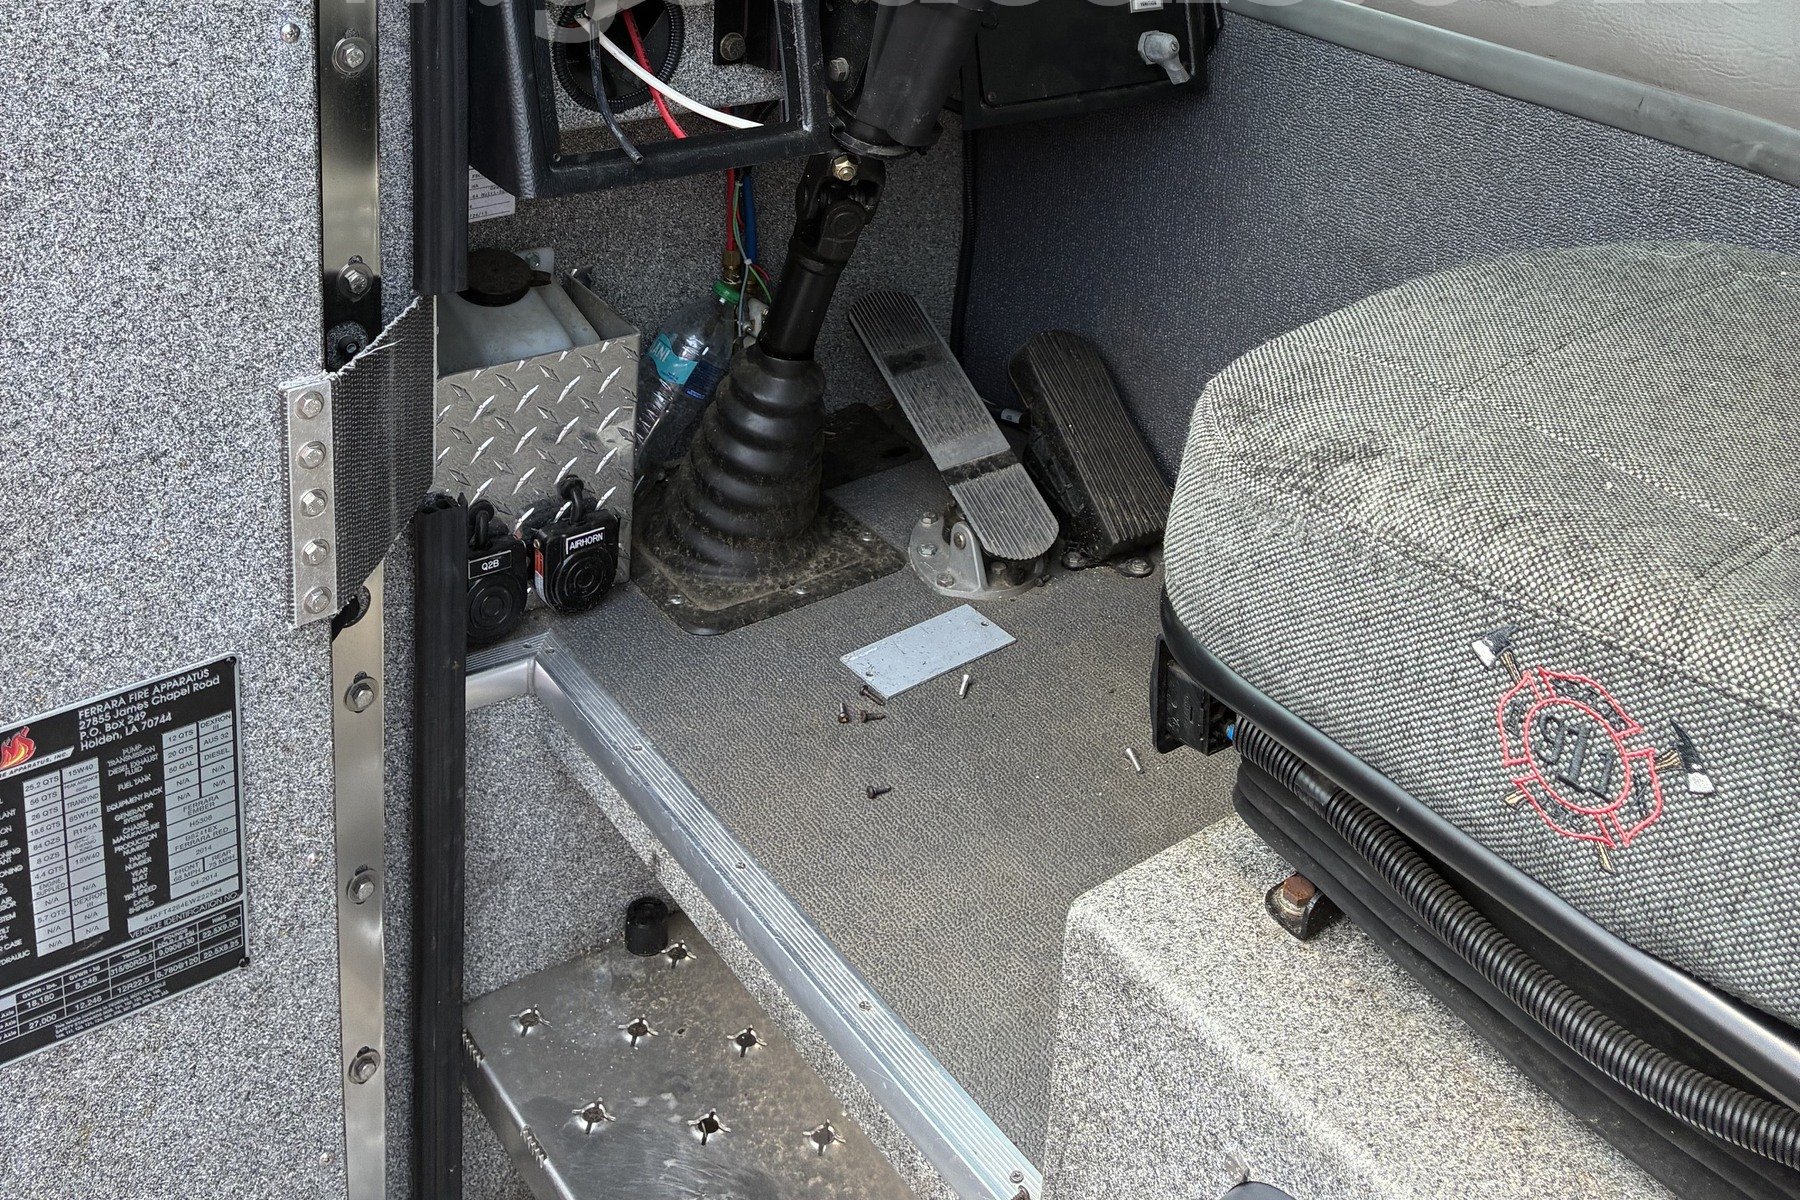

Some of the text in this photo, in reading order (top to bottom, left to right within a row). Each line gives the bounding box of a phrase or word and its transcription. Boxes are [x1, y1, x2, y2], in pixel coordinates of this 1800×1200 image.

[569, 533, 603, 550] AIRHORN
[482, 559, 500, 570] Q2B
[78, 668, 210, 720] FERRARA FIRE APPARATUS
[79, 675, 220, 731] 27855 James Chapel Road
[80, 712, 147, 740] P.O. Box 249
[201, 714, 231, 729] DEXRON
[80, 712, 172, 751] Holden, LA 70744
[168, 730, 194, 742] 12 QTS
[203, 732, 229, 746] AUS 32
[122, 744, 142, 756] PUMP
[167, 744, 194, 759] 20 QTS
[204, 748, 230, 760] DIESEL
[107, 746, 156, 768] TRANSMISSION
[9, 752, 69, 776] APPARATUS, INC.
[68, 764, 94, 776] 15W40
[108, 753, 158, 777] DIESEL EXHAUST
[179, 760, 194, 770] GAL
[212, 765, 225, 774] N/A
[25, 776, 59, 792] 25.2 QTS
[117, 774, 151, 792] FUEL TANK
[177, 778, 190, 787] N/A
[212, 780, 226, 788] N/A
[41, 792, 58, 802] QTS
[106, 786, 164, 812] EQUIPMENT RACK
[177, 792, 191, 801] N/A
[183, 795, 220, 812] FERRARA
[188, 802, 216, 816] EMBER
[31, 807, 59, 821] 26 QTS
[114, 802, 154, 821] GENERATOR
[46, 821, 61, 830] QTS
[73, 823, 97, 836] R134A
[44, 836, 61, 846] OZS
[114, 832, 157, 853] PRODUCTION
[175, 827, 229, 852] FERRARA RED
[123, 842, 150, 856] NUMBER
[196, 845, 212, 855] 2014
[43, 852, 60, 862] OZS
[75, 852, 100, 865] 15W40
[129, 852, 147, 863] PAINT
[212, 850, 232, 861] REAR
[218, 855, 236, 866] MPH
[48, 865, 64, 874] QTS
[125, 856, 152, 871] NUMBER
[175, 862, 200, 876] FRONT
[130, 867, 148, 878] YEAR
[184, 869, 201, 880] MPH
[82, 883, 97, 892] N/A
[132, 882, 148, 892] MAX
[138, 884, 157, 896] SPEED
[45, 897, 59, 906] N/A
[74, 891, 106, 906] DEXRON
[133, 896, 150, 906] DATE
[50, 909, 66, 918] QTS
[84, 911, 98, 920] N/A
[130, 892, 240, 938] VEHICLE IDENTIFICATION NO.
[47, 925, 61, 934] N/A
[86, 926, 99, 934] N/A
[49, 940, 62, 949] N/A
[69, 969, 88, 980] GVWR
[117, 976, 150, 993] 12R22.5
[22, 988, 42, 999] GVWR
[26, 994, 55, 1008] 18,180
[75, 996, 102, 1011] 12,246
[29, 1014, 57, 1030] 27,000
